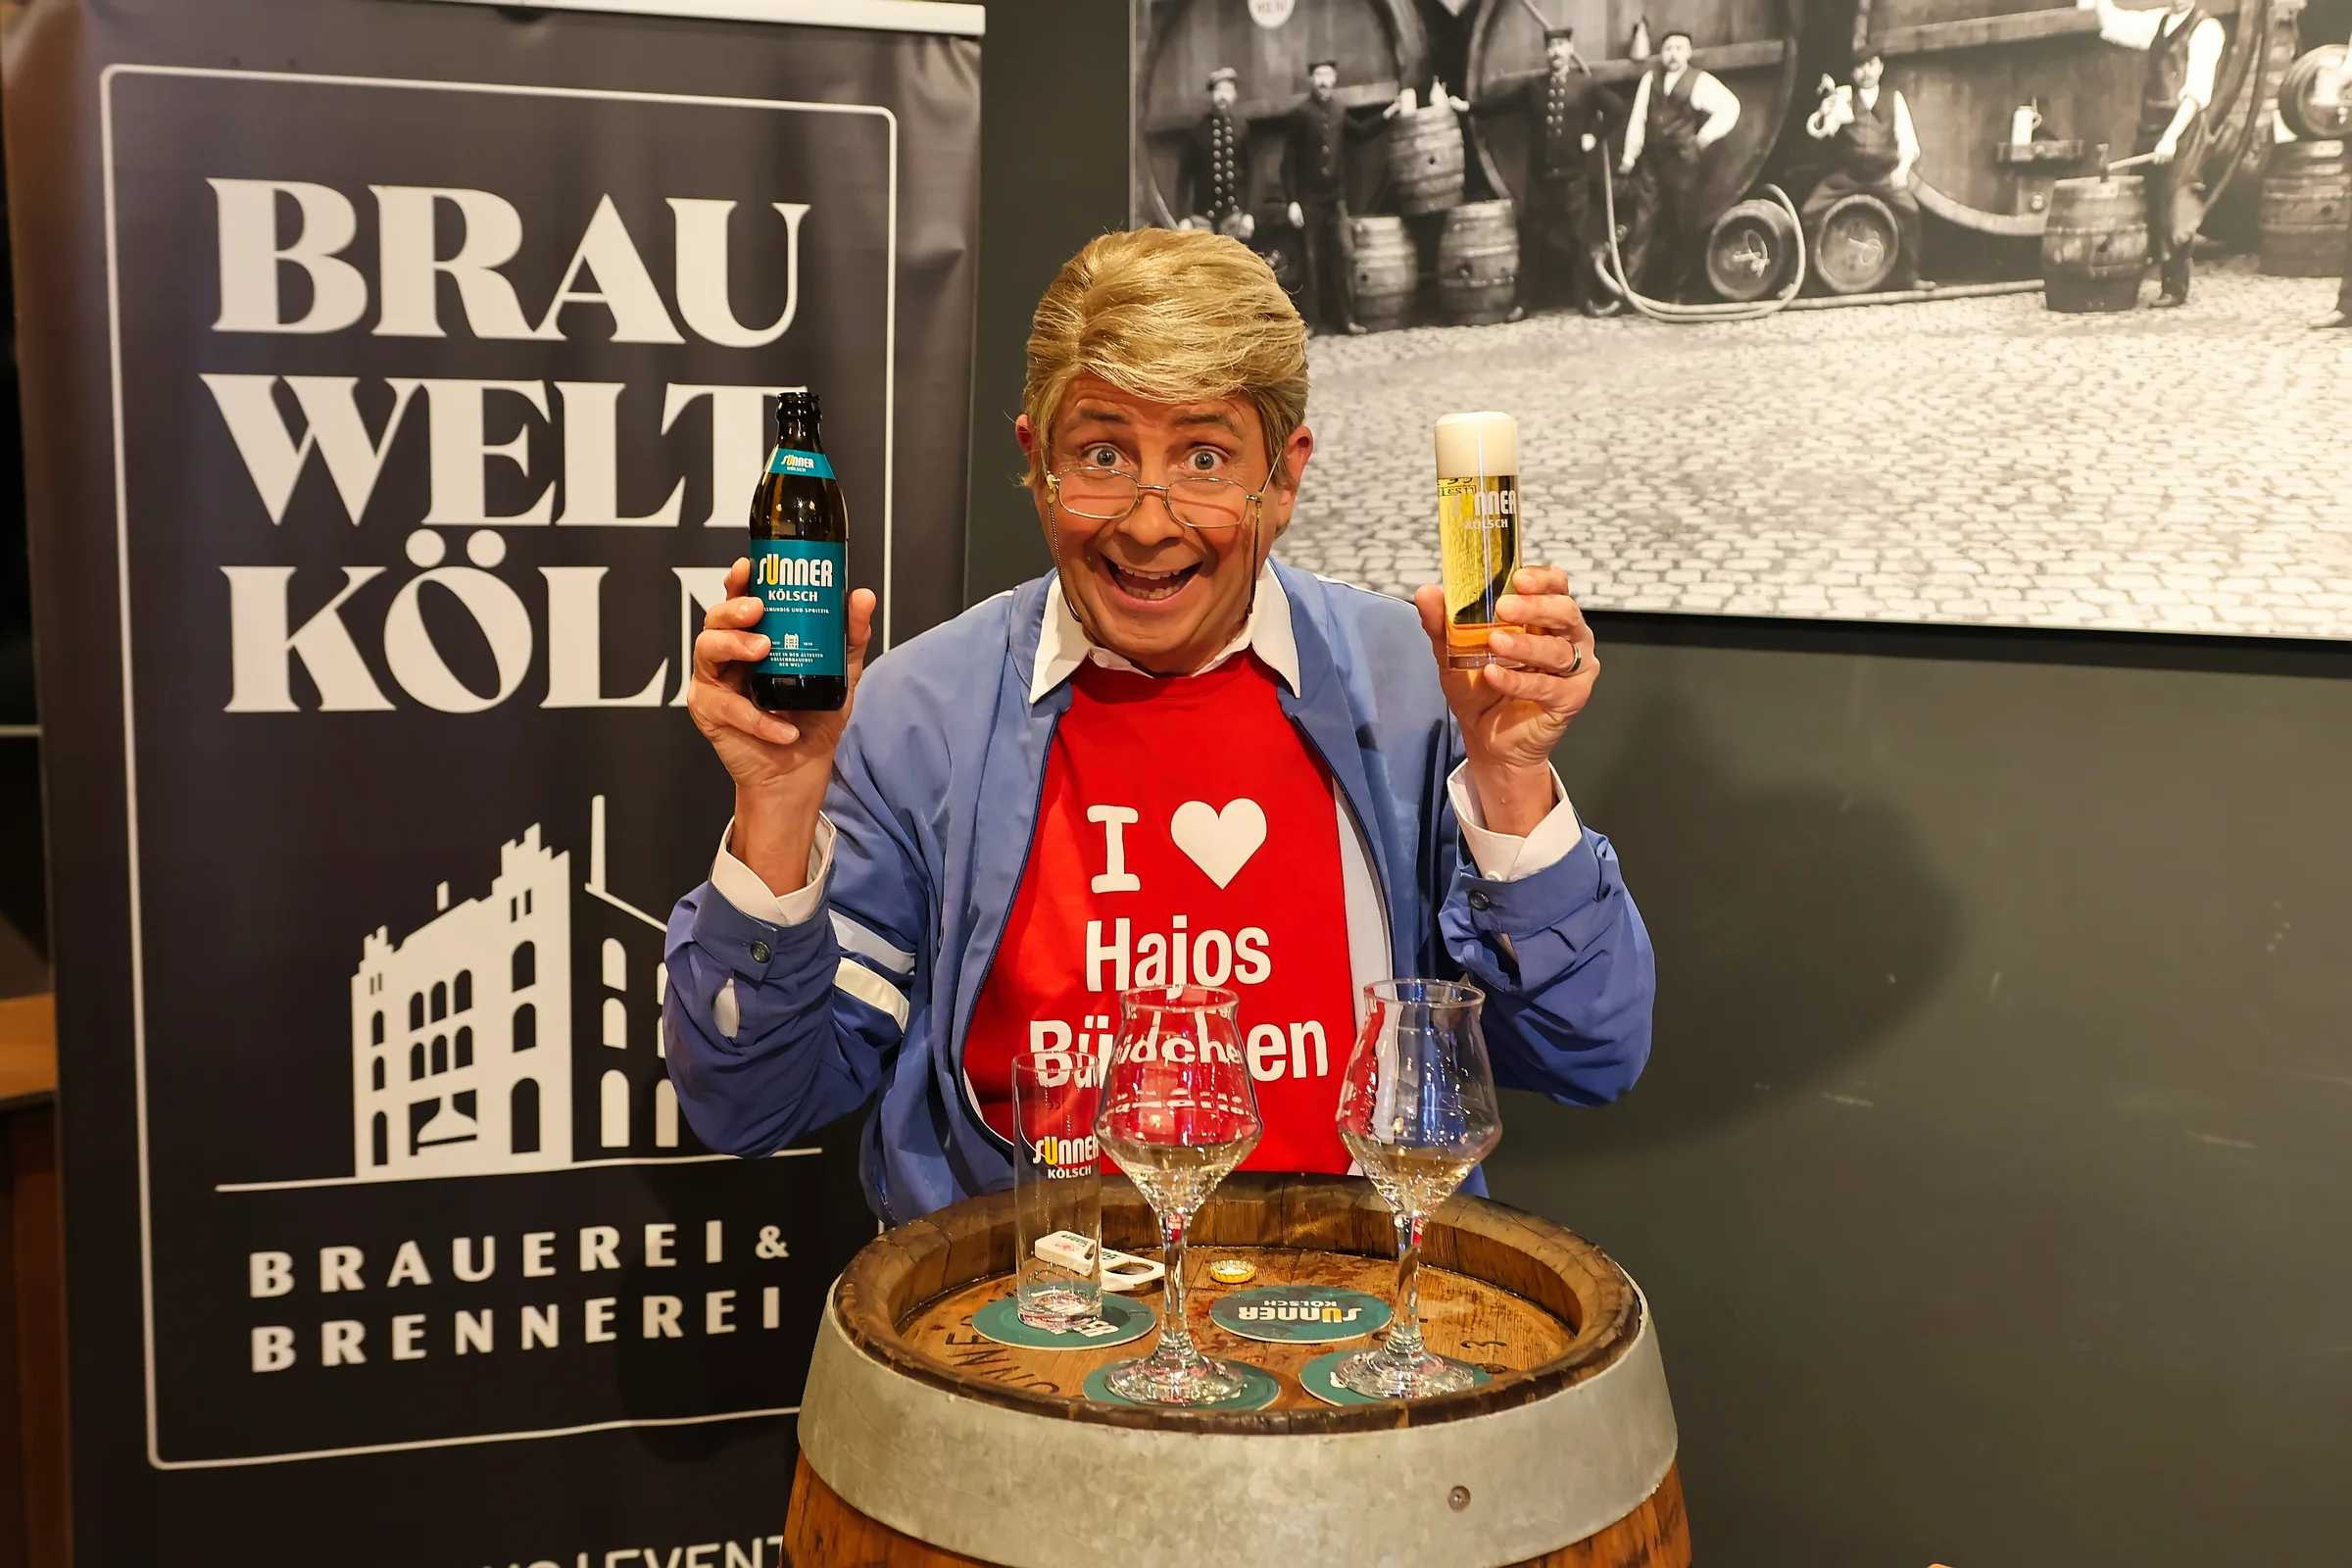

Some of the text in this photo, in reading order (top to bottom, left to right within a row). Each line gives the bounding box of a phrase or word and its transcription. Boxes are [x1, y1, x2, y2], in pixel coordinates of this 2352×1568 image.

[207, 177, 810, 348] BRAU
[199, 373, 808, 527] WELT
[768, 588, 818, 602] KÖLSCH
[1086, 805, 1141, 894] I
[1085, 914, 1272, 1000] Hajos
[1048, 1165, 1092, 1179] KÖLSCH
[249, 1220, 790, 1298] BRAUEREI &
[251, 1286, 780, 1373] BRENNEREI
[1263, 1299, 1338, 1308] KÖLSCH
